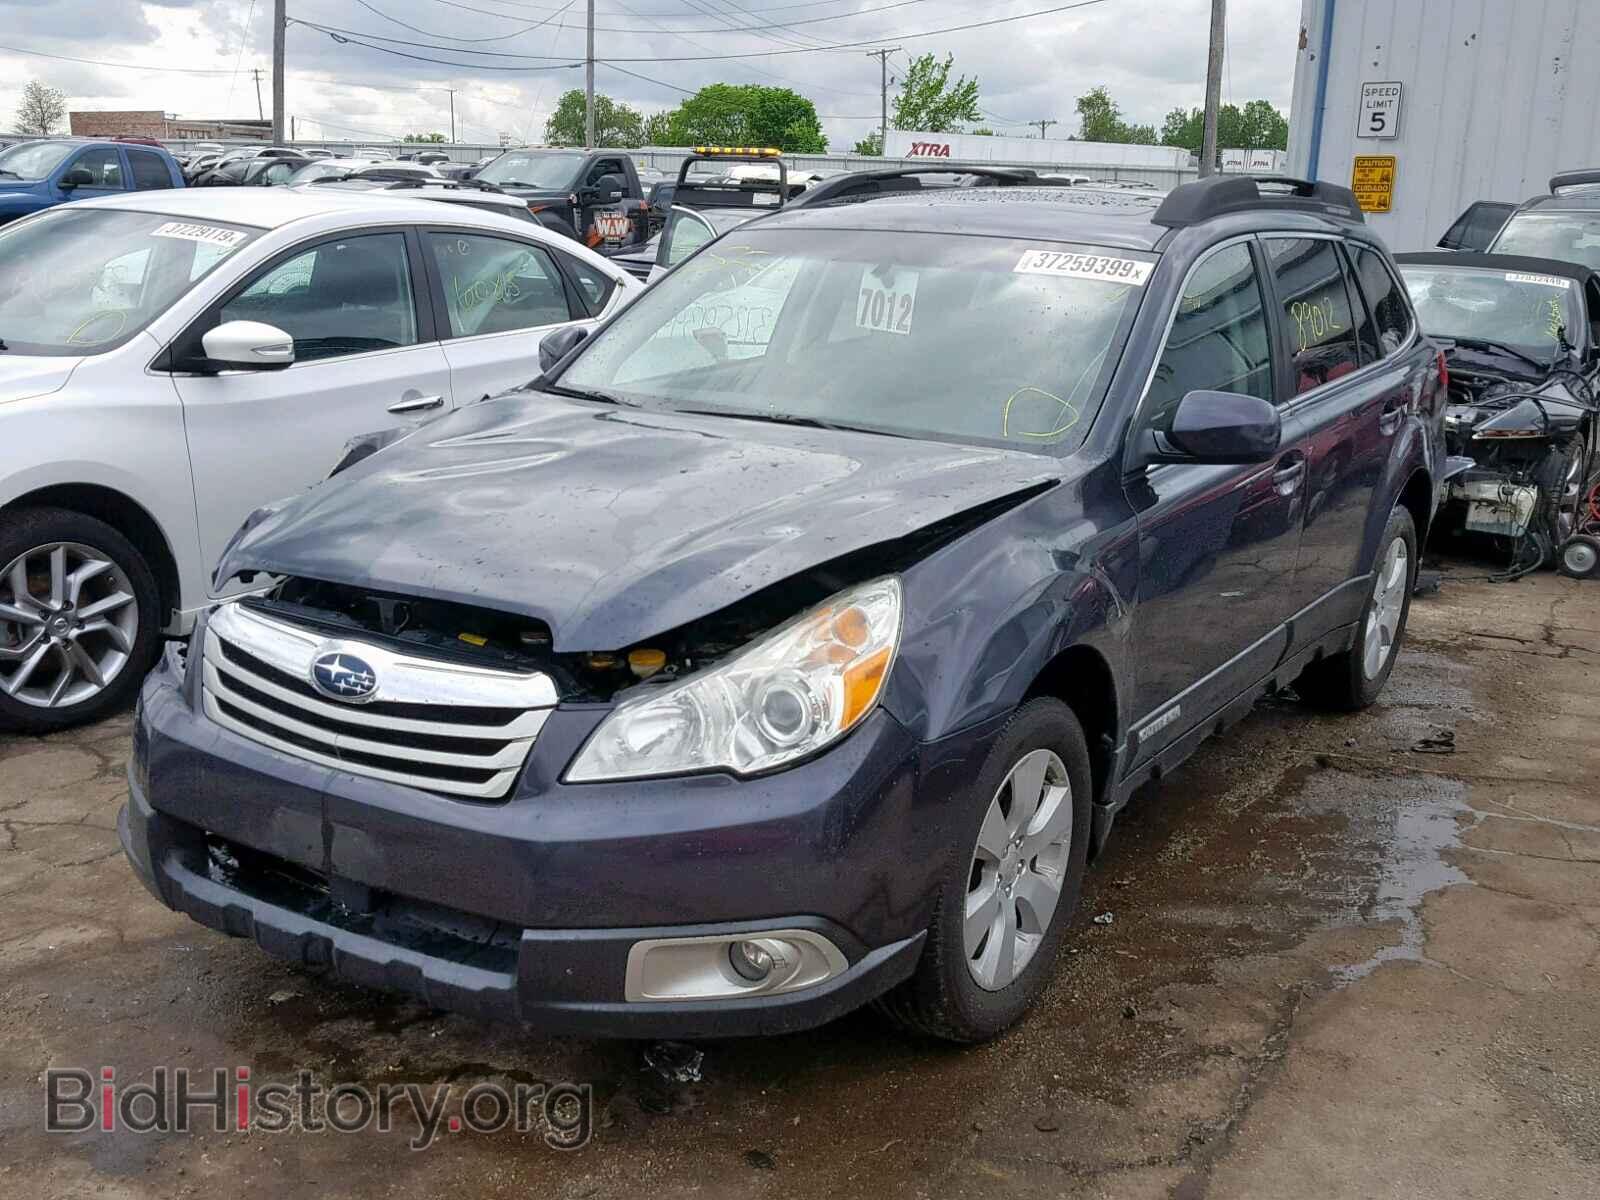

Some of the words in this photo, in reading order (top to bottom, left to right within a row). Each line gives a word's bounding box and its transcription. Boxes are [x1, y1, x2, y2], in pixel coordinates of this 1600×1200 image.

[1364, 87, 1398, 96] SPEED
[1366, 100, 1393, 108] LIMIT
[1369, 112, 1385, 132] 5
[905, 142, 949, 158] XTRA
[860, 288, 912, 331] 7012
